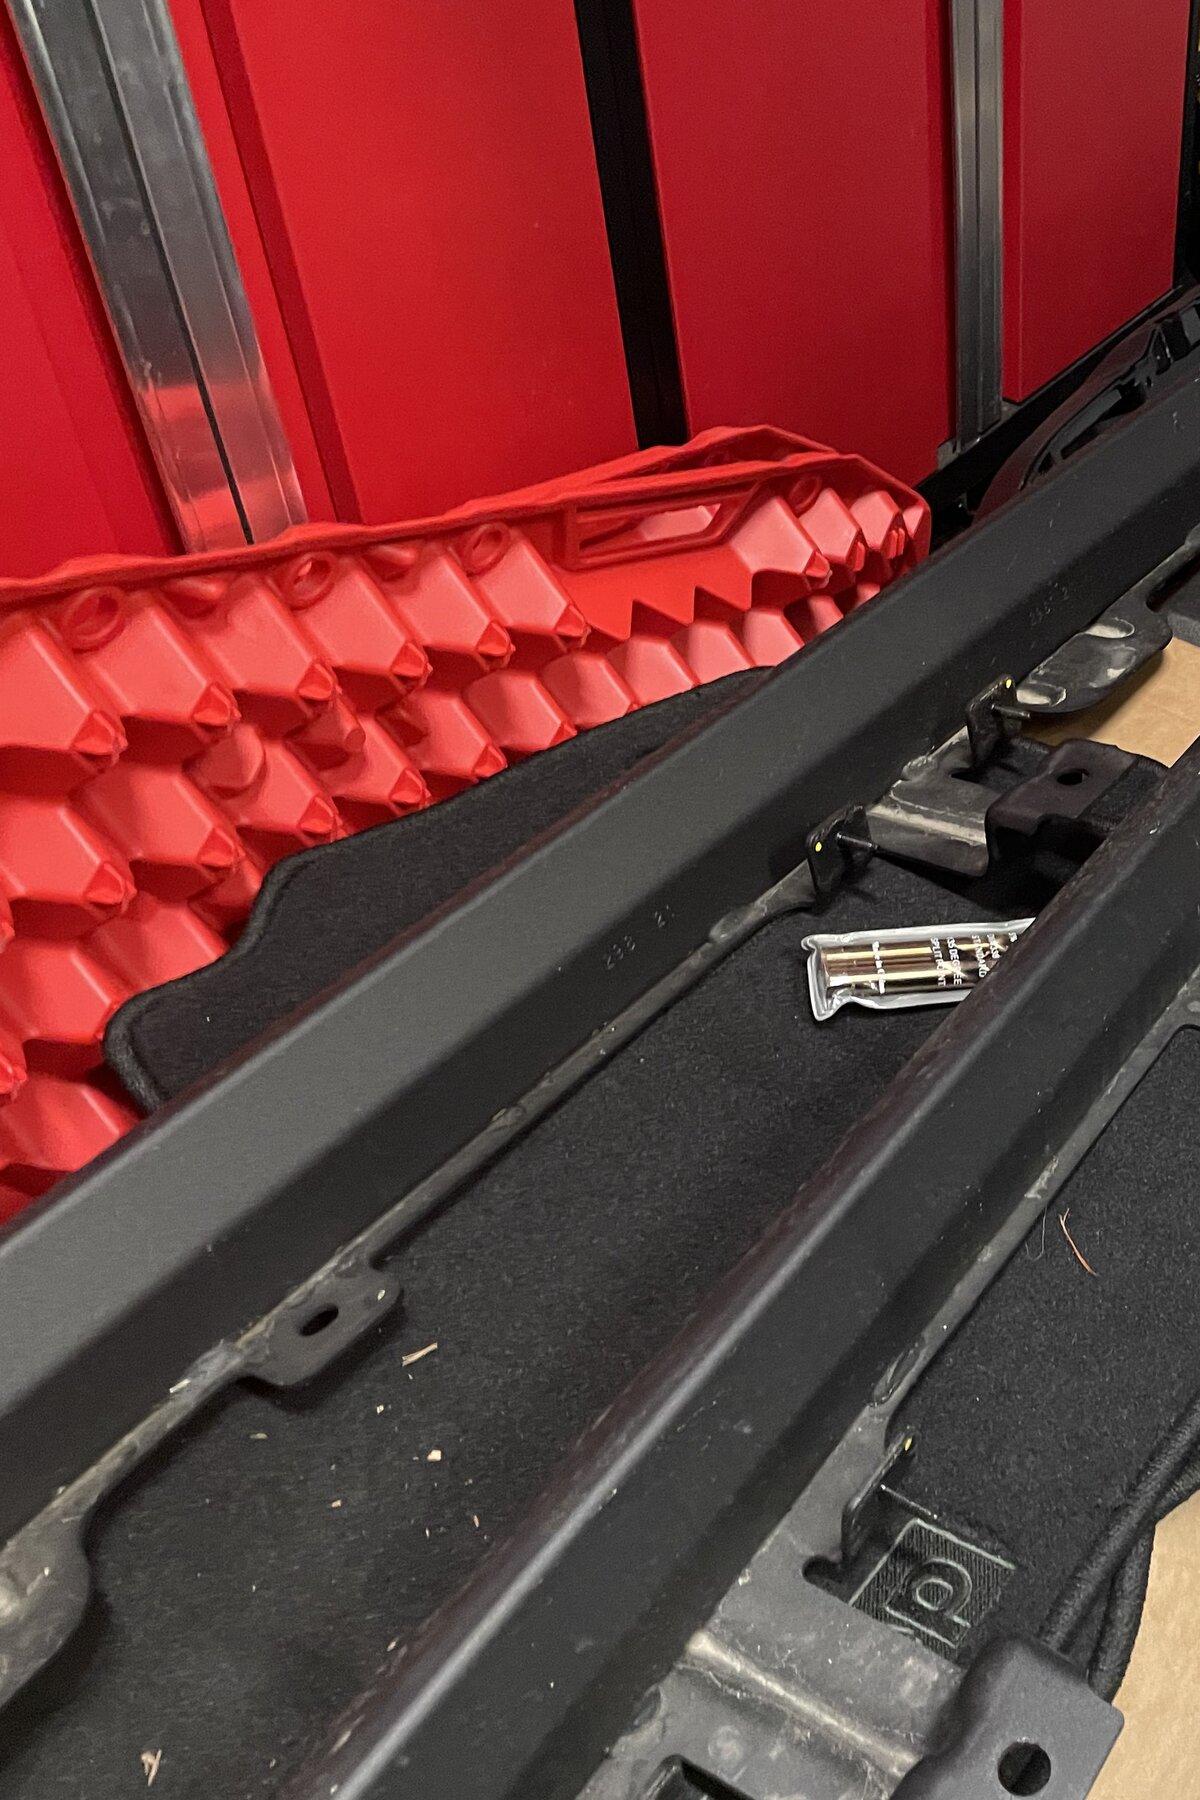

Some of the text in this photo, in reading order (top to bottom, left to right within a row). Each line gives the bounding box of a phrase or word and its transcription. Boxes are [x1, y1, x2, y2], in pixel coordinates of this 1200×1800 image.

[930, 937, 947, 987] SPLIT POINT
[948, 948, 962, 986] DEGREE
[971, 934, 990, 978] STANDARD
